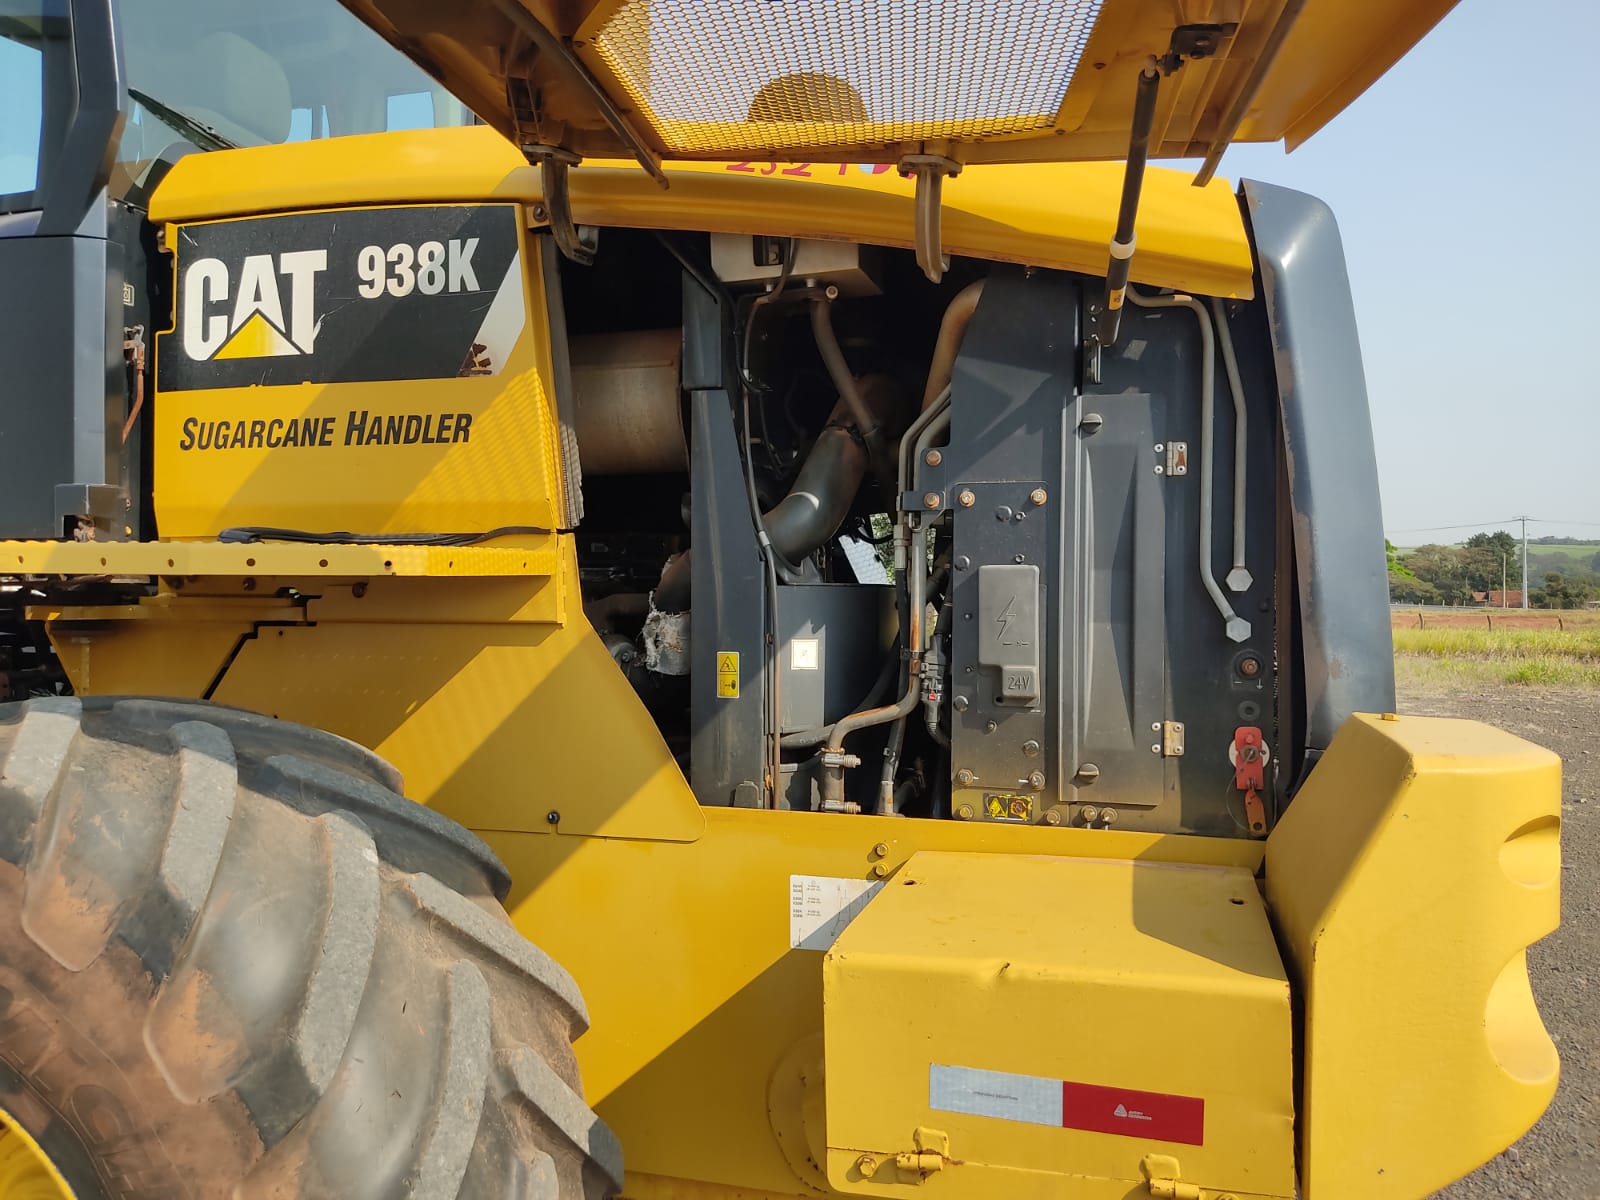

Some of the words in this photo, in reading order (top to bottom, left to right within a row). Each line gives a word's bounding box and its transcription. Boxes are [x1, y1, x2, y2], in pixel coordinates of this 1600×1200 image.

[358, 238, 480, 298] 938K
[184, 249, 327, 361] CAT
[181, 418, 336, 451] SUGARCANE
[344, 411, 472, 446] HANDLER
[1007, 675, 1031, 691] 24V
